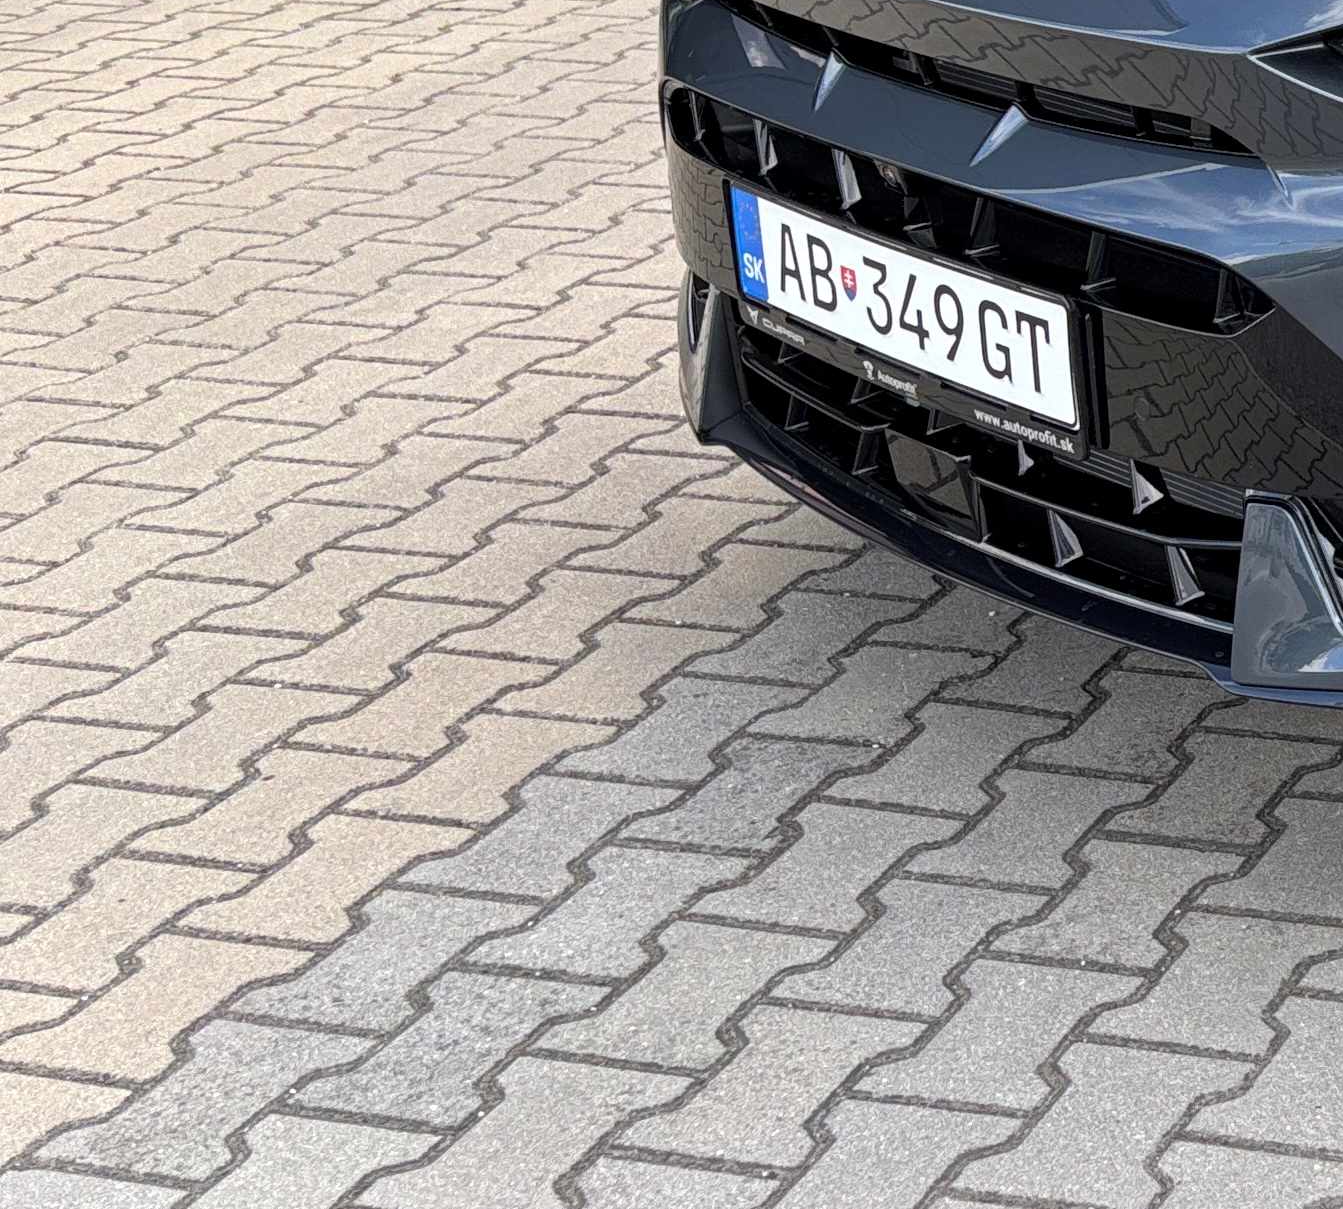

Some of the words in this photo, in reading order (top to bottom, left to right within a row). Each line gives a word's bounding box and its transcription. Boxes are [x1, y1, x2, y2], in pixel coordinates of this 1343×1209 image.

[743, 251, 766, 284] SK
[780, 223, 838, 313] AB
[862, 255, 1051, 394] 349GT
[973, 408, 1076, 454] www.autoprofit.sk
